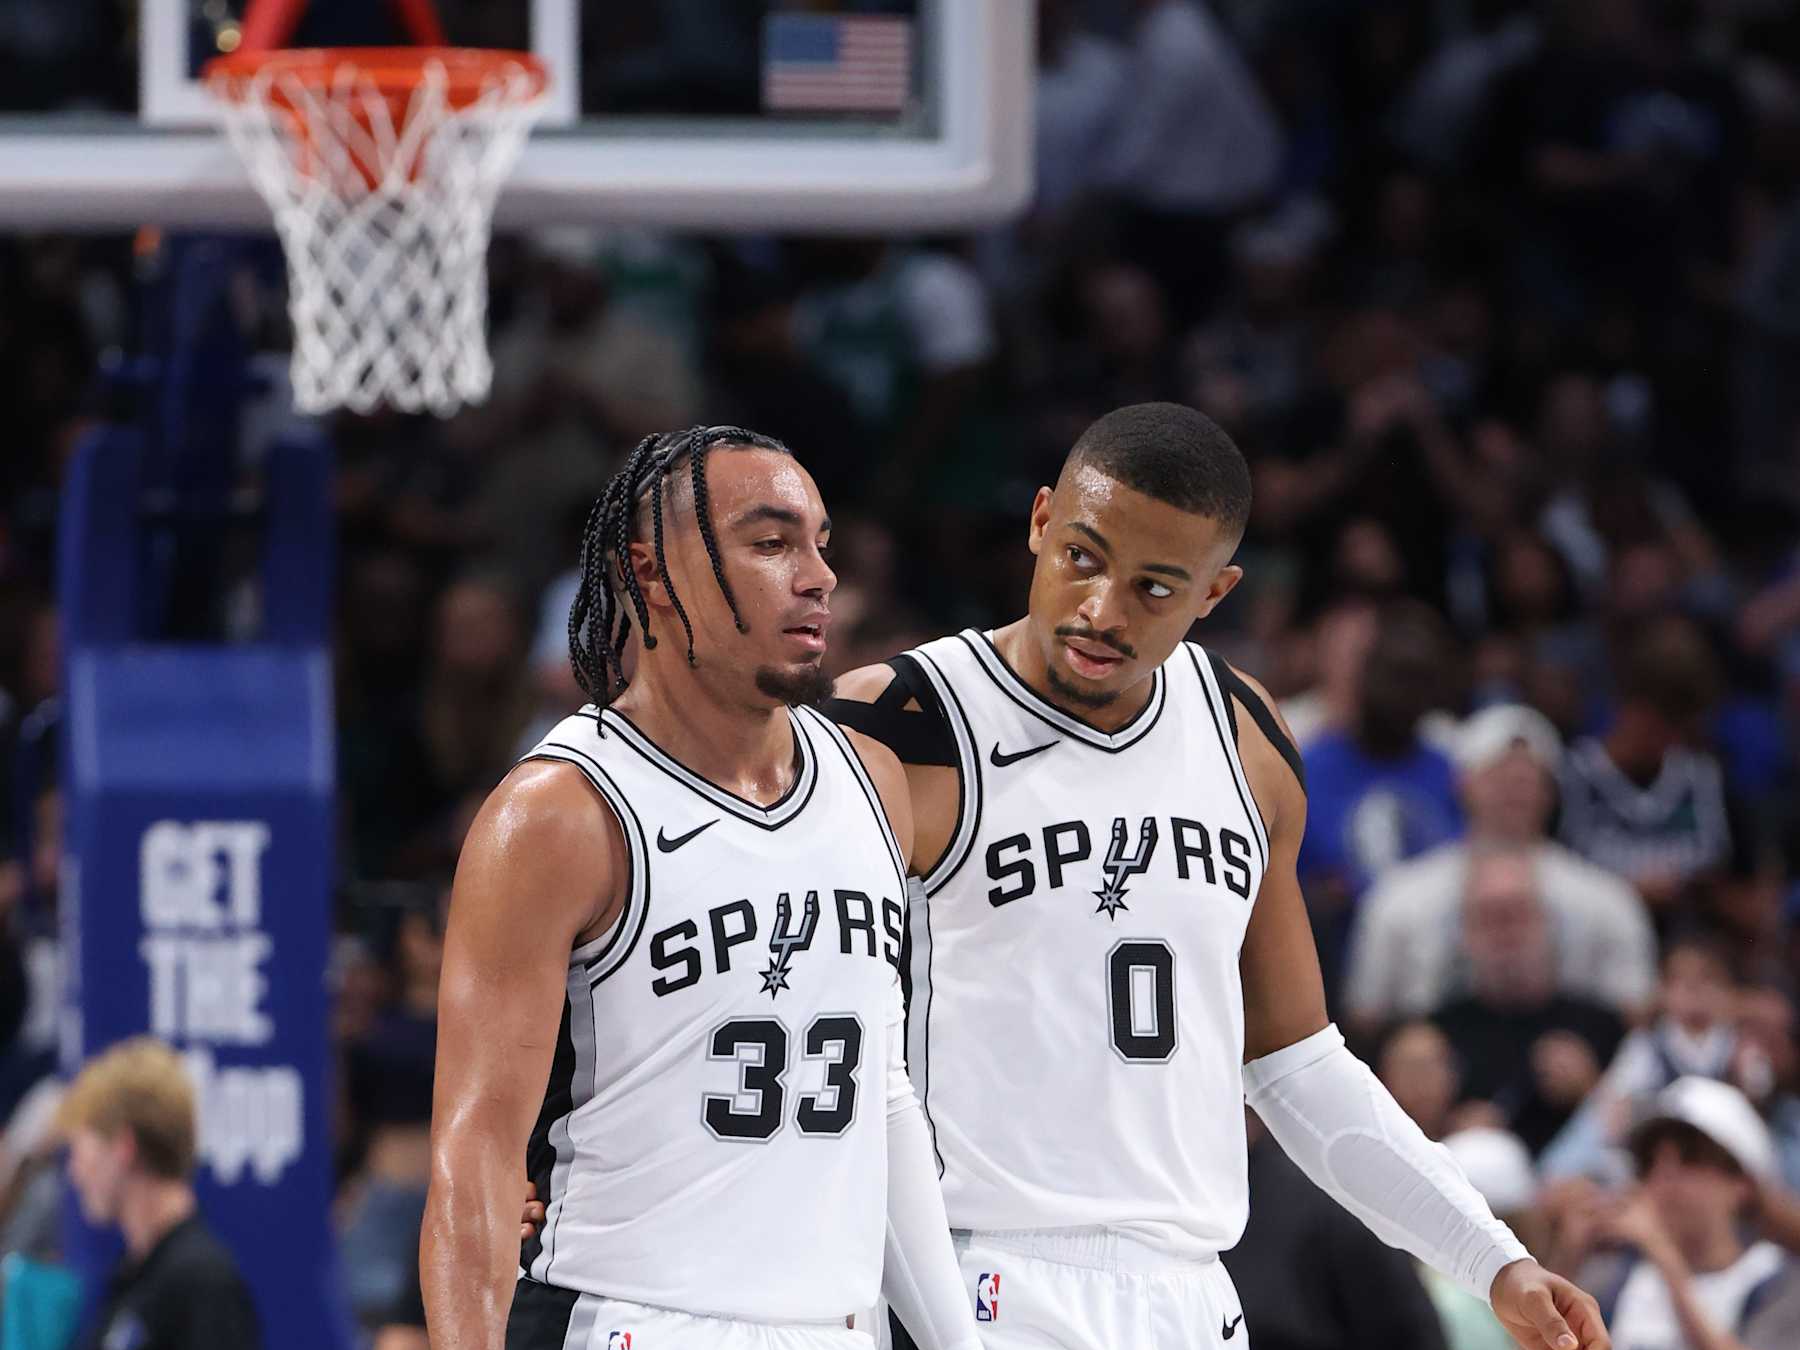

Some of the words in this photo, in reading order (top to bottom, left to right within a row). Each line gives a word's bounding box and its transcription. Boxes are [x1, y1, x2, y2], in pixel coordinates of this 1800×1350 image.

[140, 820, 271, 928] GET
[985, 816, 1251, 921] SPURS
[139, 932, 274, 1046] THE
[650, 889, 902, 1000] SPURS
[1105, 937, 1179, 1064] 0
[700, 1011, 863, 1144] 33
